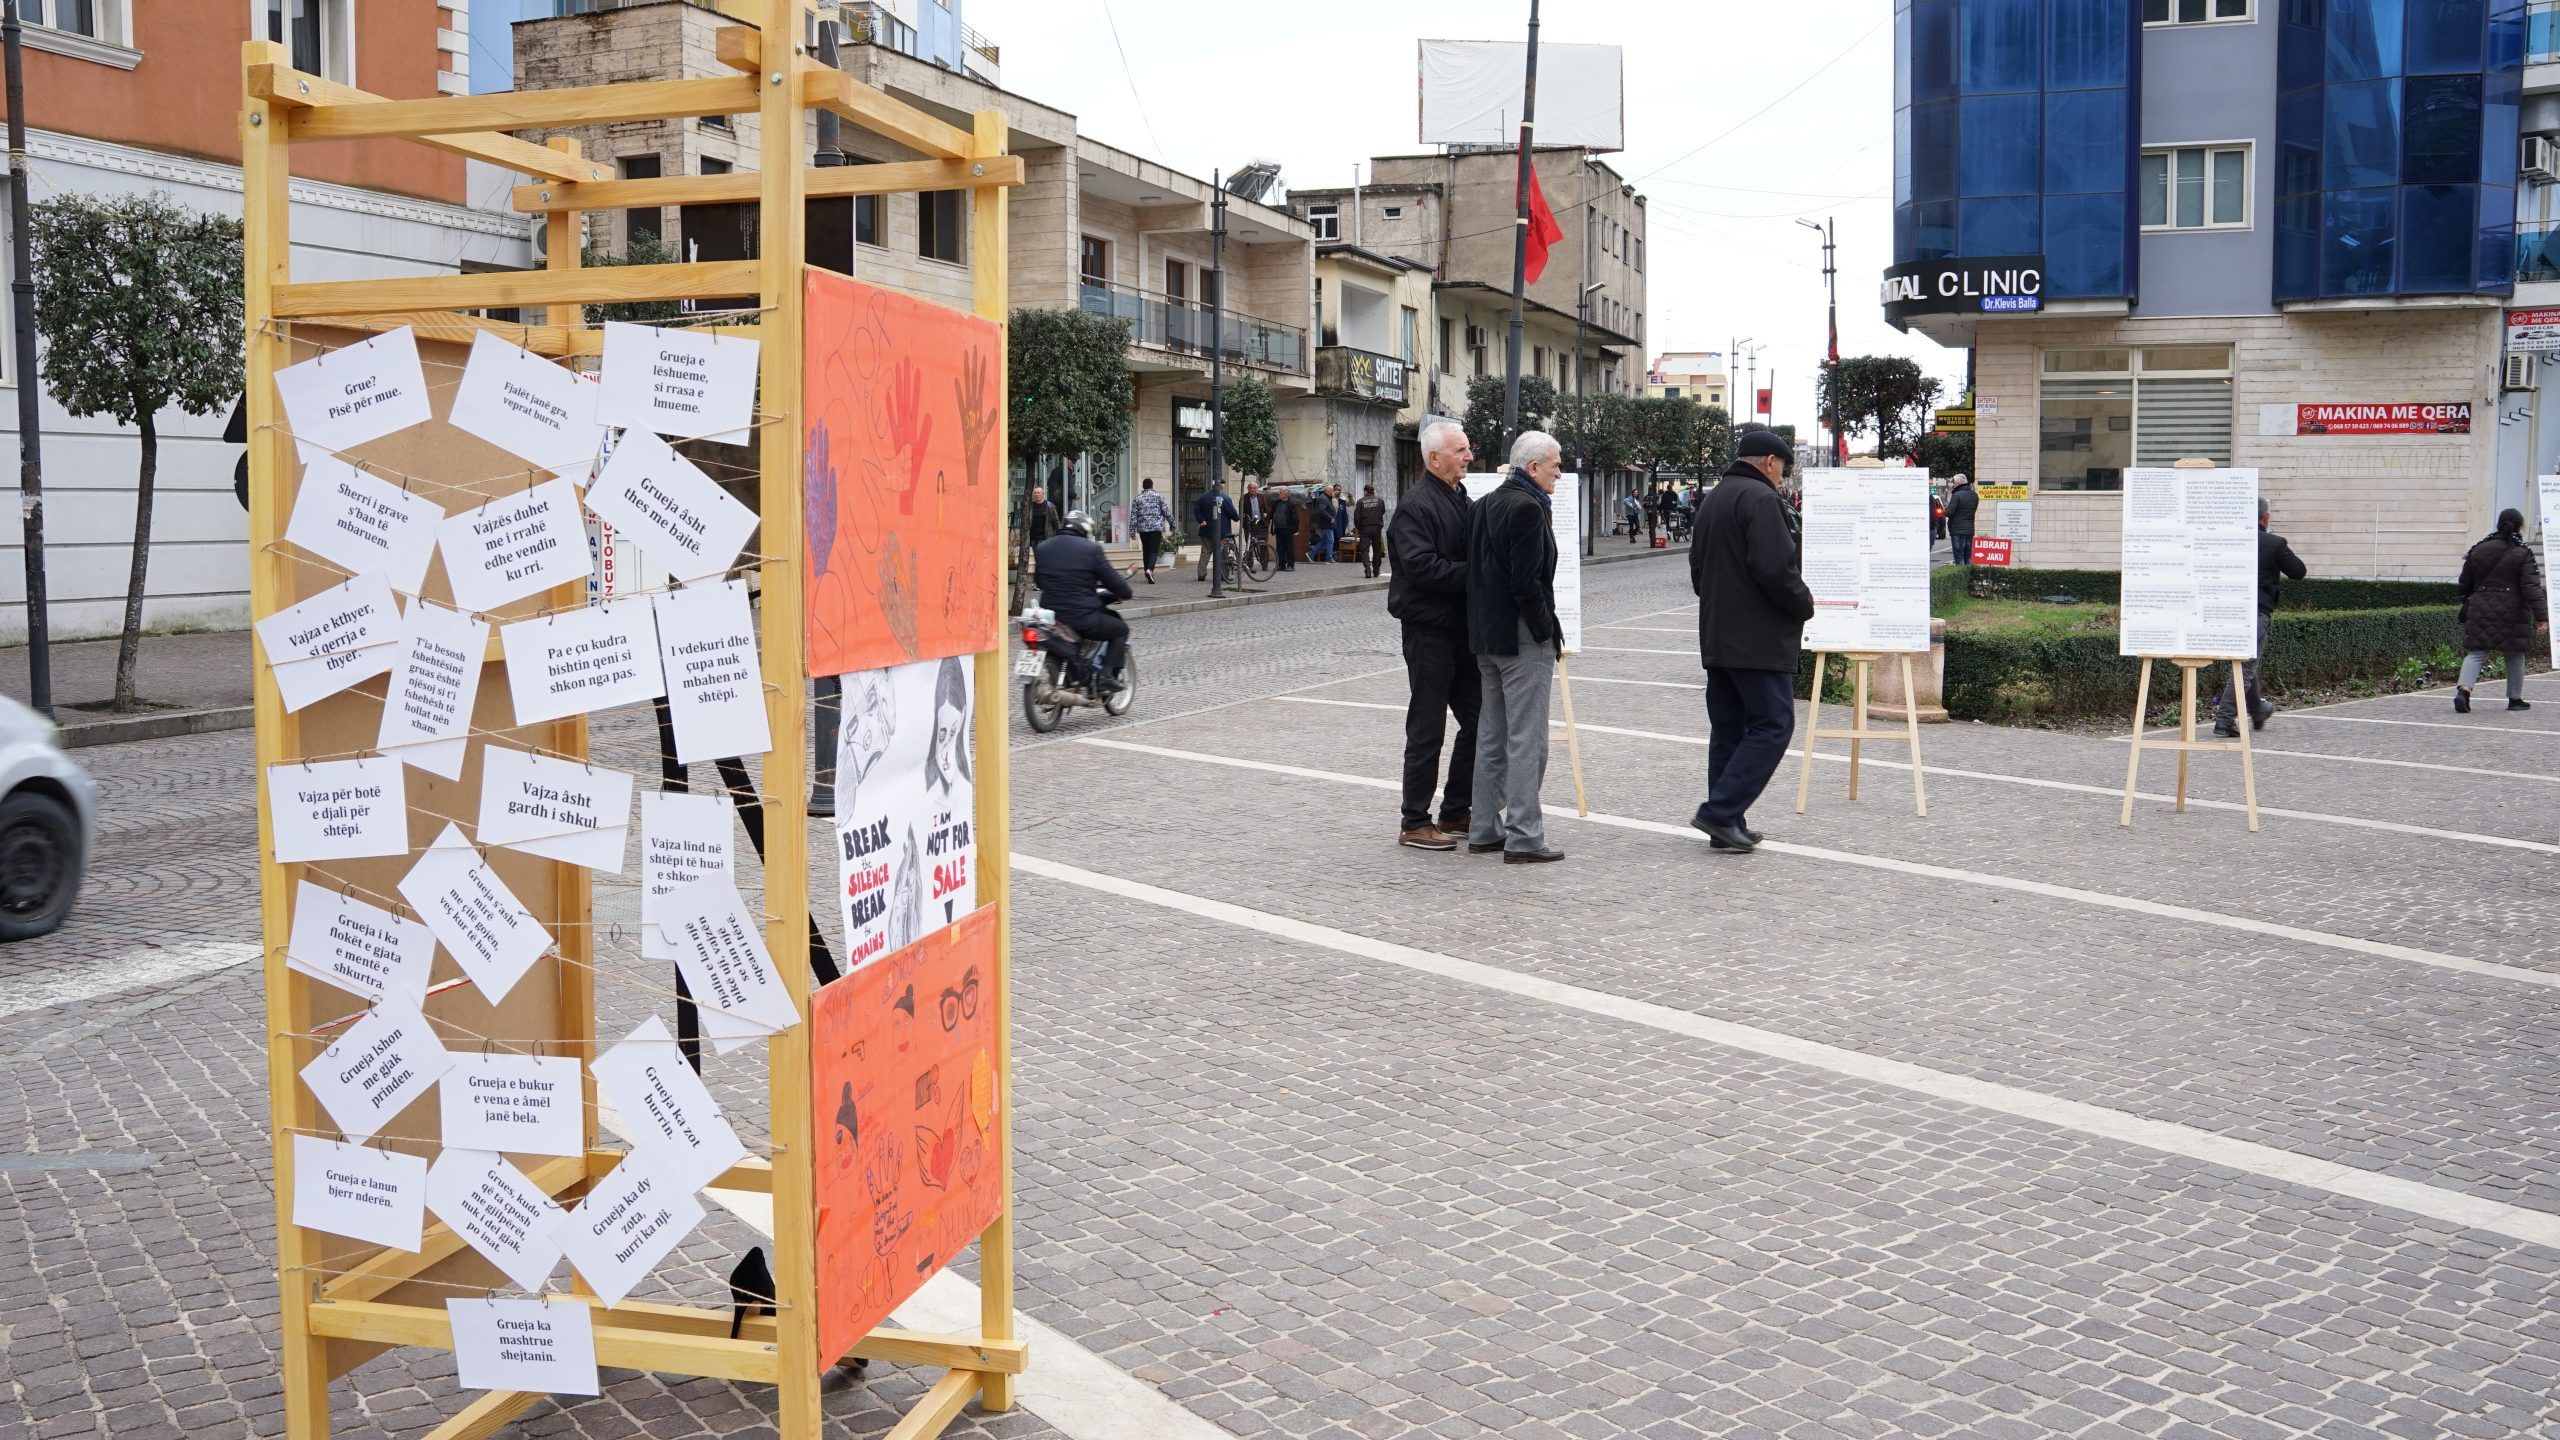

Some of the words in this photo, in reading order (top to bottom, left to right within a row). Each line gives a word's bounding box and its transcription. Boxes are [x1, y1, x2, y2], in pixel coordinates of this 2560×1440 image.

[1939, 270, 2040, 297] CLINIC
[659, 349, 696, 366] Grueja
[697, 357, 705, 367] e
[344, 374, 376, 395] Grue?
[652, 364, 708, 384] lëshueme,
[1376, 358, 1403, 386] SHITET
[327, 401, 352, 419] Pisë
[352, 395, 372, 413] për
[373, 387, 402, 403] mue.
[503, 380, 530, 400] Fjalët
[528, 393, 551, 409] janë
[549, 405, 568, 420] gra,
[653, 381, 663, 392] si
[665, 384, 695, 397] rrasa
[696, 388, 704, 398] e
[503, 396, 533, 416] veprat
[532, 408, 560, 430] burra.
[652, 395, 700, 413] lmueme.
[2318, 407, 2387, 420] MAKINA
[2392, 407, 2417, 419] ME
[2421, 405, 2470, 420] QERA
[337, 482, 372, 506] Sherri
[371, 498, 378, 509] i
[376, 503, 408, 523] grave
[640, 476, 679, 514] Grueja
[678, 508, 706, 535] âsht
[376, 518, 389, 531] të
[471, 514, 512, 535] Vajzës
[512, 500, 549, 522] duhet
[623, 487, 650, 513] thes
[648, 509, 669, 529] me
[667, 521, 701, 556] bajtë.
[336, 517, 389, 549] mbaruem.
[484, 536, 504, 551] me
[504, 531, 511, 544] i
[512, 518, 546, 541] rrahë
[1974, 541, 2008, 550] LIBRARI
[483, 552, 513, 570] edhe
[514, 537, 557, 559] vendin
[1986, 552, 2004, 562] JAKU
[504, 568, 522, 582] ku
[523, 559, 544, 575] rri.
[287, 626, 322, 647] Vajza
[322, 622, 331, 633] e
[329, 603, 374, 629] kthyer,
[310, 646, 319, 657] si
[321, 631, 358, 653] qerrja
[359, 627, 366, 635] e
[547, 647, 563, 660] Pa
[564, 646, 572, 656] e
[574, 642, 589, 656] çu
[677, 637, 725, 655] vdekuri
[726, 634, 749, 648] dhe
[326, 650, 361, 670] thyer.
[547, 658, 590, 677] bishtin
[592, 651, 619, 670] qeni
[620, 648, 632, 662] si
[685, 658, 714, 674] çupa
[715, 652, 741, 666] nuk
[549, 678, 586, 694] shkon
[587, 672, 610, 687] nga
[611, 667, 636, 684] pas.
[681, 673, 731, 689] mbahen
[732, 667, 748, 681] në
[697, 686, 738, 703] shtëpi.
[297, 790, 330, 805] Vajza
[331, 787, 352, 804] për
[353, 784, 381, 799] botë
[521, 780, 559, 801] Vajza
[560, 789, 592, 808] âsht
[311, 810, 319, 820] e
[320, 805, 348, 821] djali
[349, 804, 370, 820] për
[507, 800, 548, 818] gardh
[550, 807, 556, 820] i
[933, 814, 938, 827] I
[940, 809, 951, 825] AM
[322, 822, 362, 838] shtëpi.
[842, 814, 891, 861] BREAK
[926, 827, 949, 856] NOT
[952, 821, 970, 850] FOR
[862, 858, 872, 871] the
[933, 855, 966, 900] SALE
[848, 863, 890, 897] SILENCE
[851, 888, 886, 929] BREAK
[851, 931, 884, 966] CHAINS
[339, 1052, 375, 1084] Grueja
[370, 1028, 403, 1057] lshon
[361, 1071, 380, 1090] me
[378, 1052, 403, 1079] gjak
[467, 1075, 507, 1091] Grueja
[508, 1080, 516, 1089] e
[517, 1077, 555, 1091] bukur
[370, 1069, 414, 1109] prinden.
[473, 1094, 480, 1104] e
[481, 1095, 510, 1106] vena
[512, 1096, 520, 1106] e
[521, 1094, 551, 1108] âmël
[484, 1108, 510, 1123] janë
[511, 1110, 540, 1124] bela.
[643, 1092, 673, 1140] burrin.
[644, 1065, 675, 1110] Grueja
[671, 1106, 686, 1127] ka
[682, 1126, 700, 1149] zot
[592, 1203, 626, 1236] Grueja
[621, 1190, 639, 1207] ka
[636, 1176, 651, 1194] dy
[614, 1233, 644, 1264] burri
[639, 1224, 657, 1240] ka
[653, 1208, 672, 1228] nji.
[620, 1211, 646, 1235] zota,
[496, 1317, 535, 1332] Grueja
[536, 1319, 551, 1331] ka
[498, 1334, 554, 1347] mashtrue
[499, 1348, 556, 1363] shejtanin.
